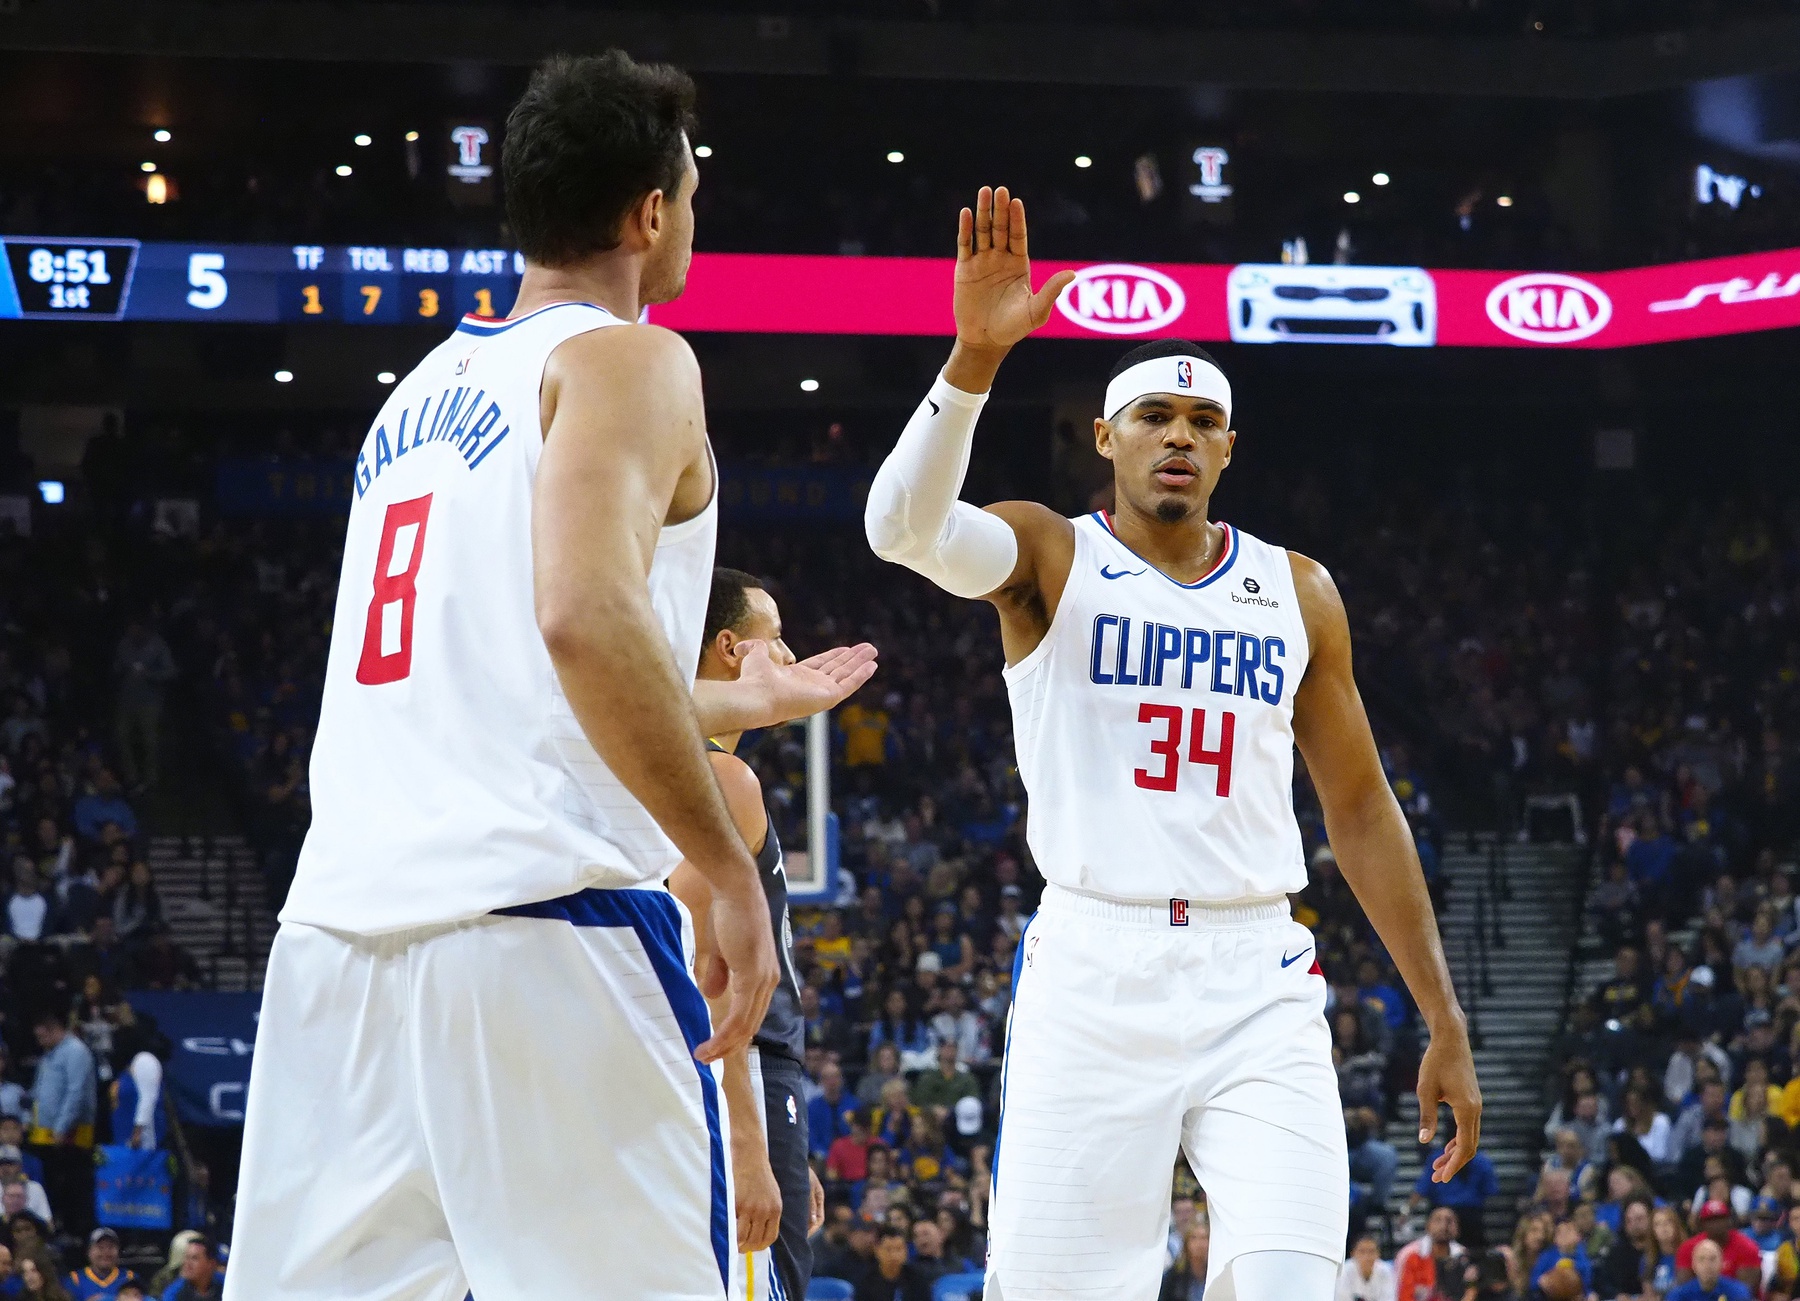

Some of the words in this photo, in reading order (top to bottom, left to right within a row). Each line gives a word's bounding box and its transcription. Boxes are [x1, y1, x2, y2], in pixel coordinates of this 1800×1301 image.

[29, 249, 111, 284] 8:51
[293, 246, 324, 270] TF
[348, 247, 394, 272] TOL
[403, 248, 449, 273] REB
[460, 250, 507, 274] AST
[49, 284, 90, 309] 1st
[187, 253, 228, 309] 5
[302, 285, 323, 314] 1
[360, 285, 382, 315] 7
[419, 288, 439, 317] 3
[475, 288, 495, 317] 1
[1077, 279, 1165, 319] KIA
[1507, 288, 1592, 328] KIA
[355, 386, 510, 501] GALLINARI
[356, 492, 433, 686] 8
[1231, 592, 1279, 608] bumble
[1090, 613, 1286, 706] CLIPPERS
[1134, 702, 1236, 798] 34
